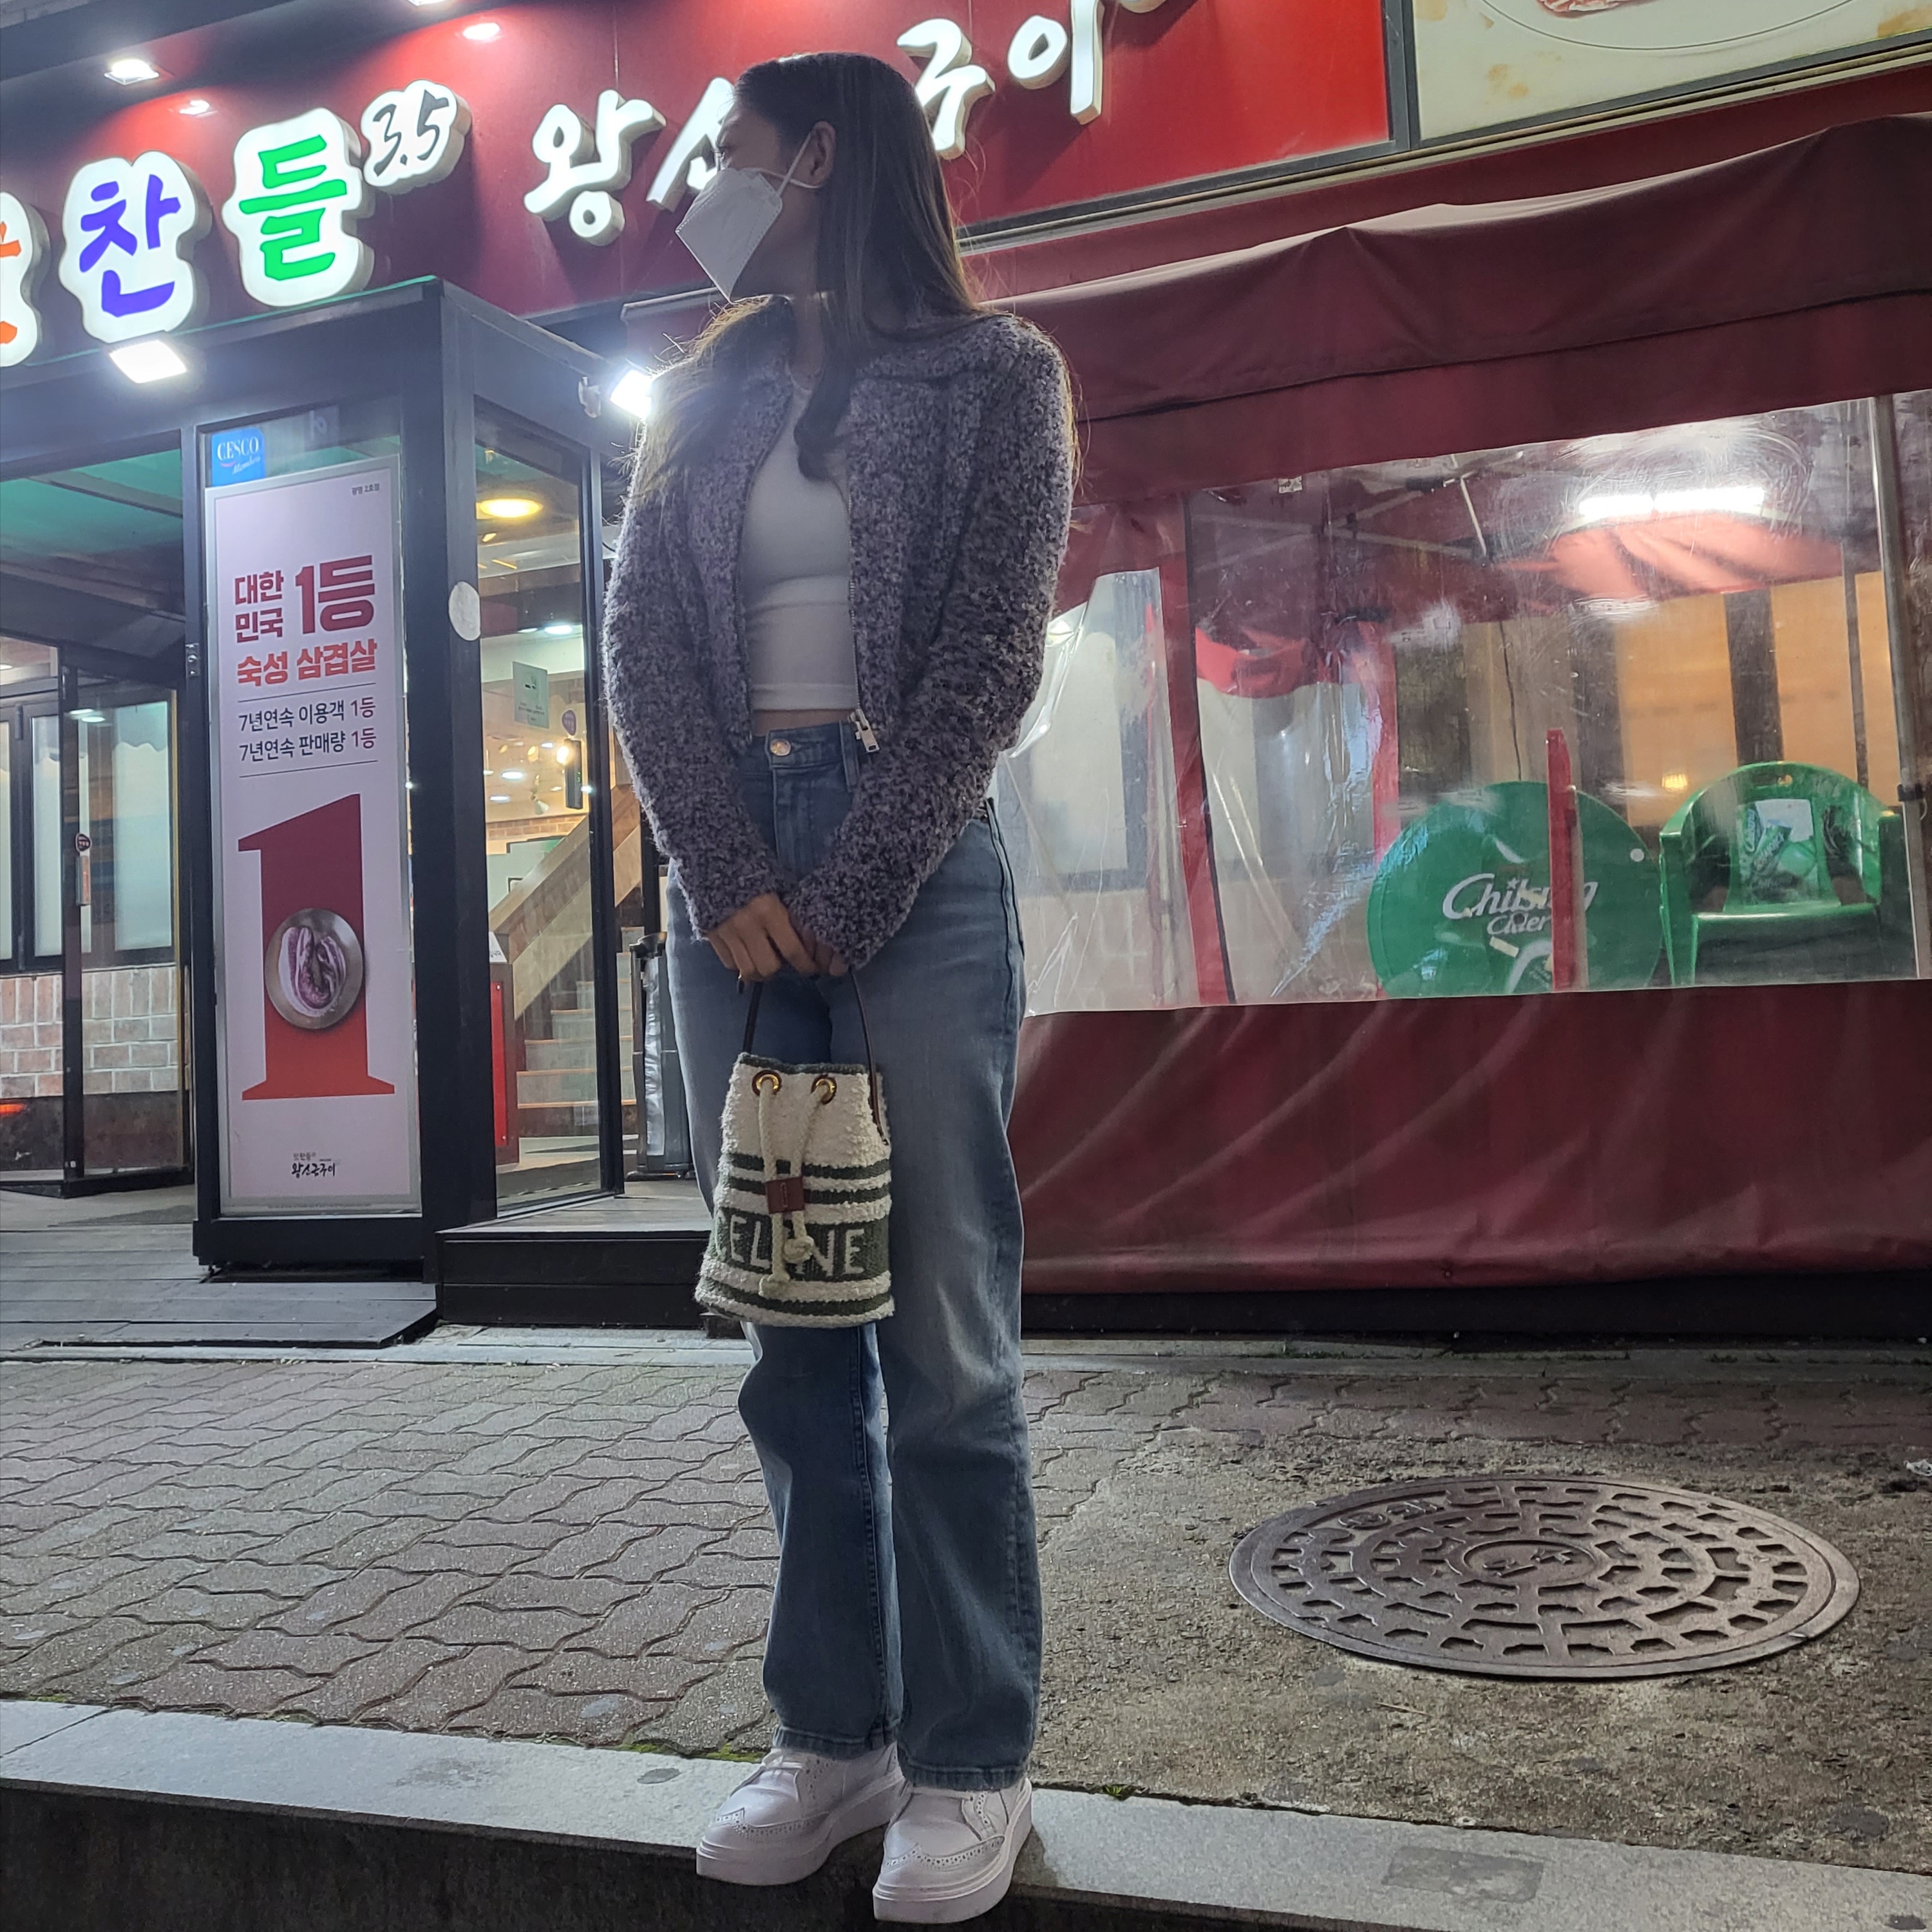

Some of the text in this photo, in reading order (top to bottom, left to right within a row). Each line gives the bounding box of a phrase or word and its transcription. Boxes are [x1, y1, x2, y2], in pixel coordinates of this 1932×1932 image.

[0, 0, 1095, 345] 찬들 3.5 왕소구이
[217, 437, 259, 460] CESCO
[234, 570, 284, 605] 대한
[295, 554, 375, 635] 1등
[235, 607, 283, 643] 민국
[237, 638, 377, 687] 숙성 삼겹살
[238, 696, 376, 732] 7년연속 이용객 1등
[239, 727, 377, 762] 7년연속 판매량 1등
[1442, 873, 1598, 919] Chils
